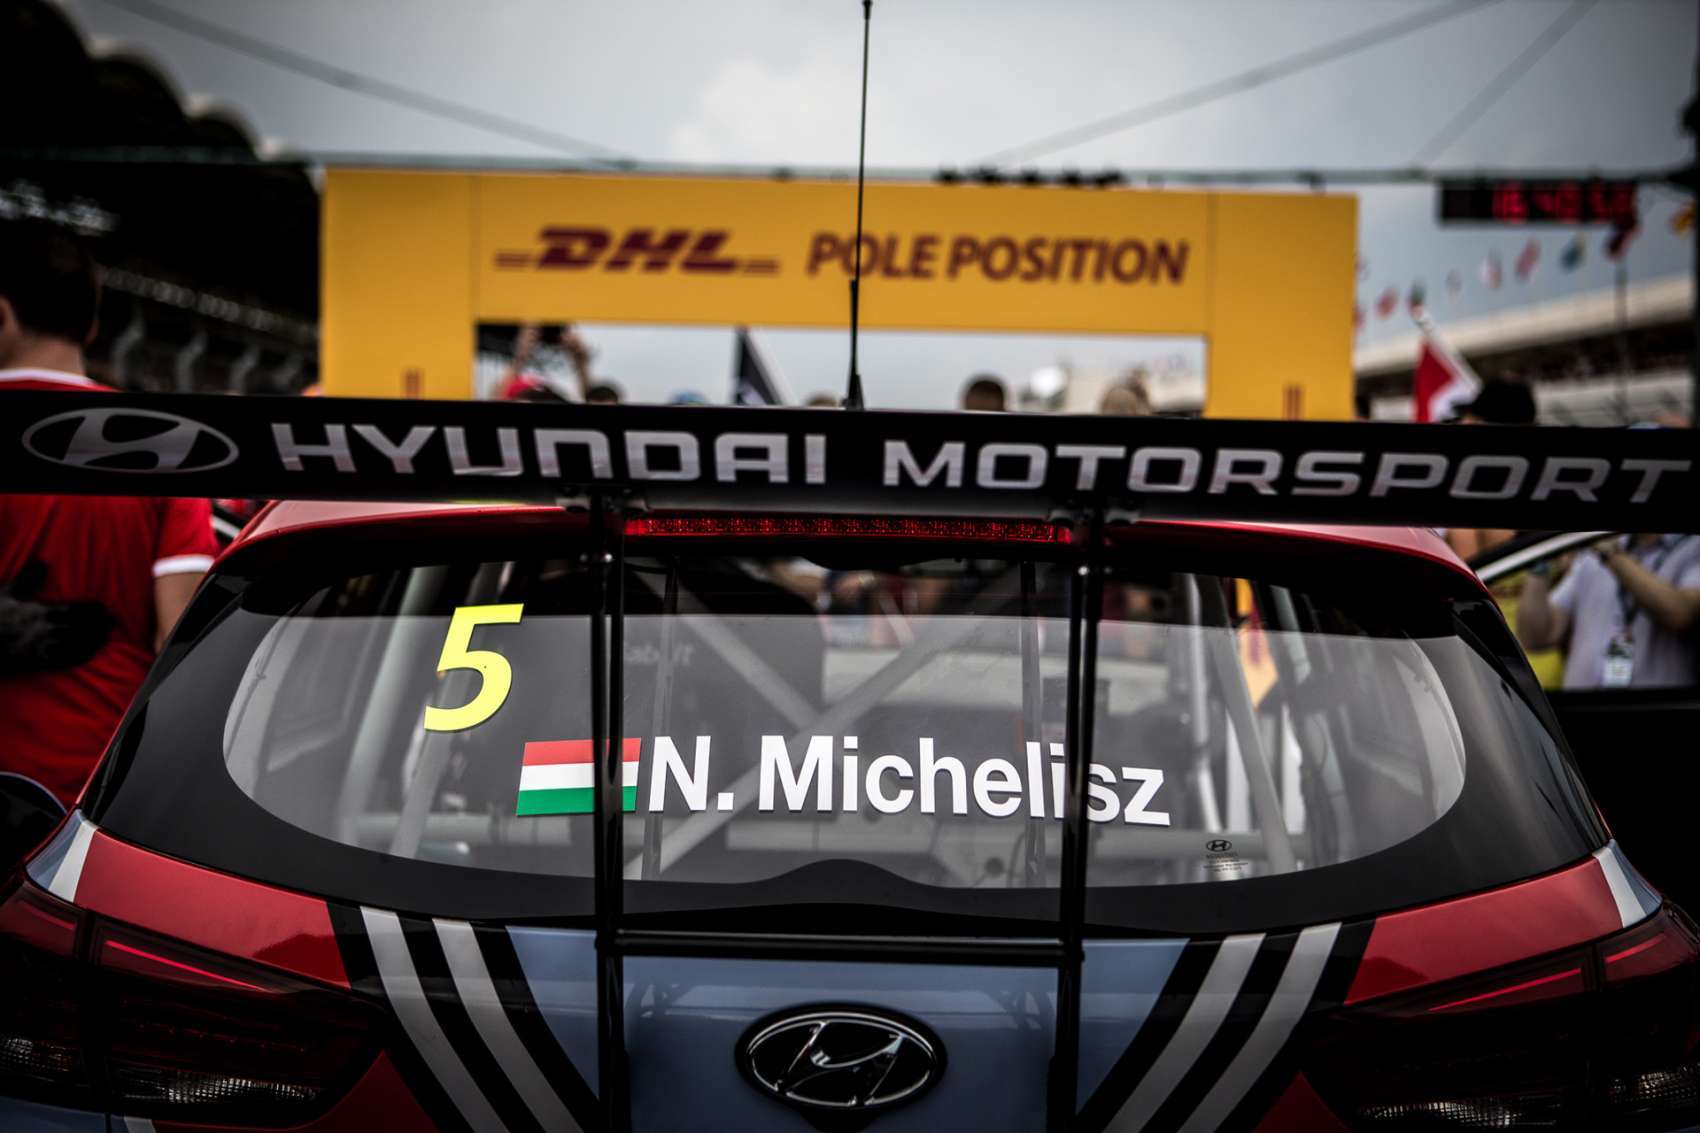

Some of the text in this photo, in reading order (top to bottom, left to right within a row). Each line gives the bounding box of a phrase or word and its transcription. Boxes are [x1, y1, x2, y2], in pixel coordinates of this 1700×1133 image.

[536, 226, 738, 273] DHL
[807, 233, 1190, 284] POLE POSITION
[271, 423, 1690, 502] HYUNDAI MOTORSPORT
[425, 604, 524, 731] 5
[648, 735, 1171, 826] N. Michelisz
